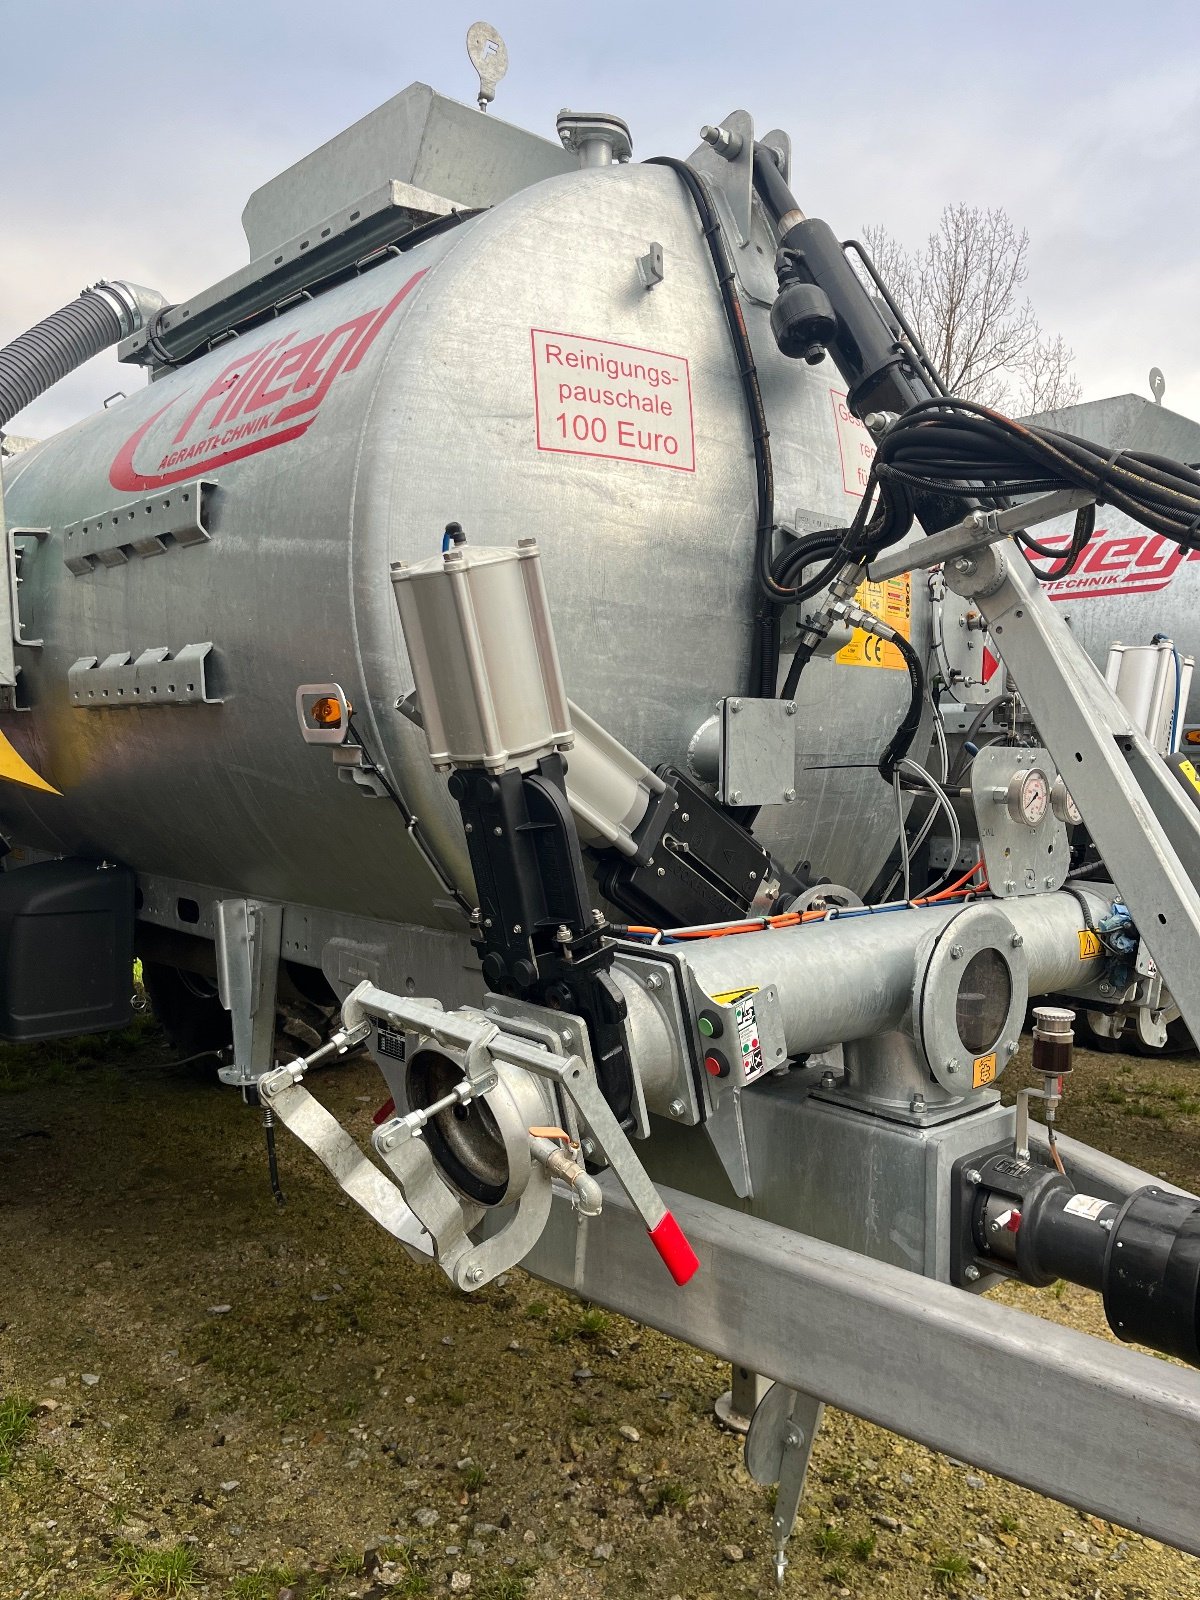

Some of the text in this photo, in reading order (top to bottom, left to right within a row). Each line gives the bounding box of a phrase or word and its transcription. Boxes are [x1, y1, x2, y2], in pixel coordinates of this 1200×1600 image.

[172, 266, 431, 445] Fliegl
[545, 343, 679, 387] Reinigungs-
[559, 383, 673, 416] pauschale
[157, 411, 275, 472] AGRARTECHNIK
[556, 412, 679, 455] 100 Euro
[1024, 529, 1200, 583] lieg
